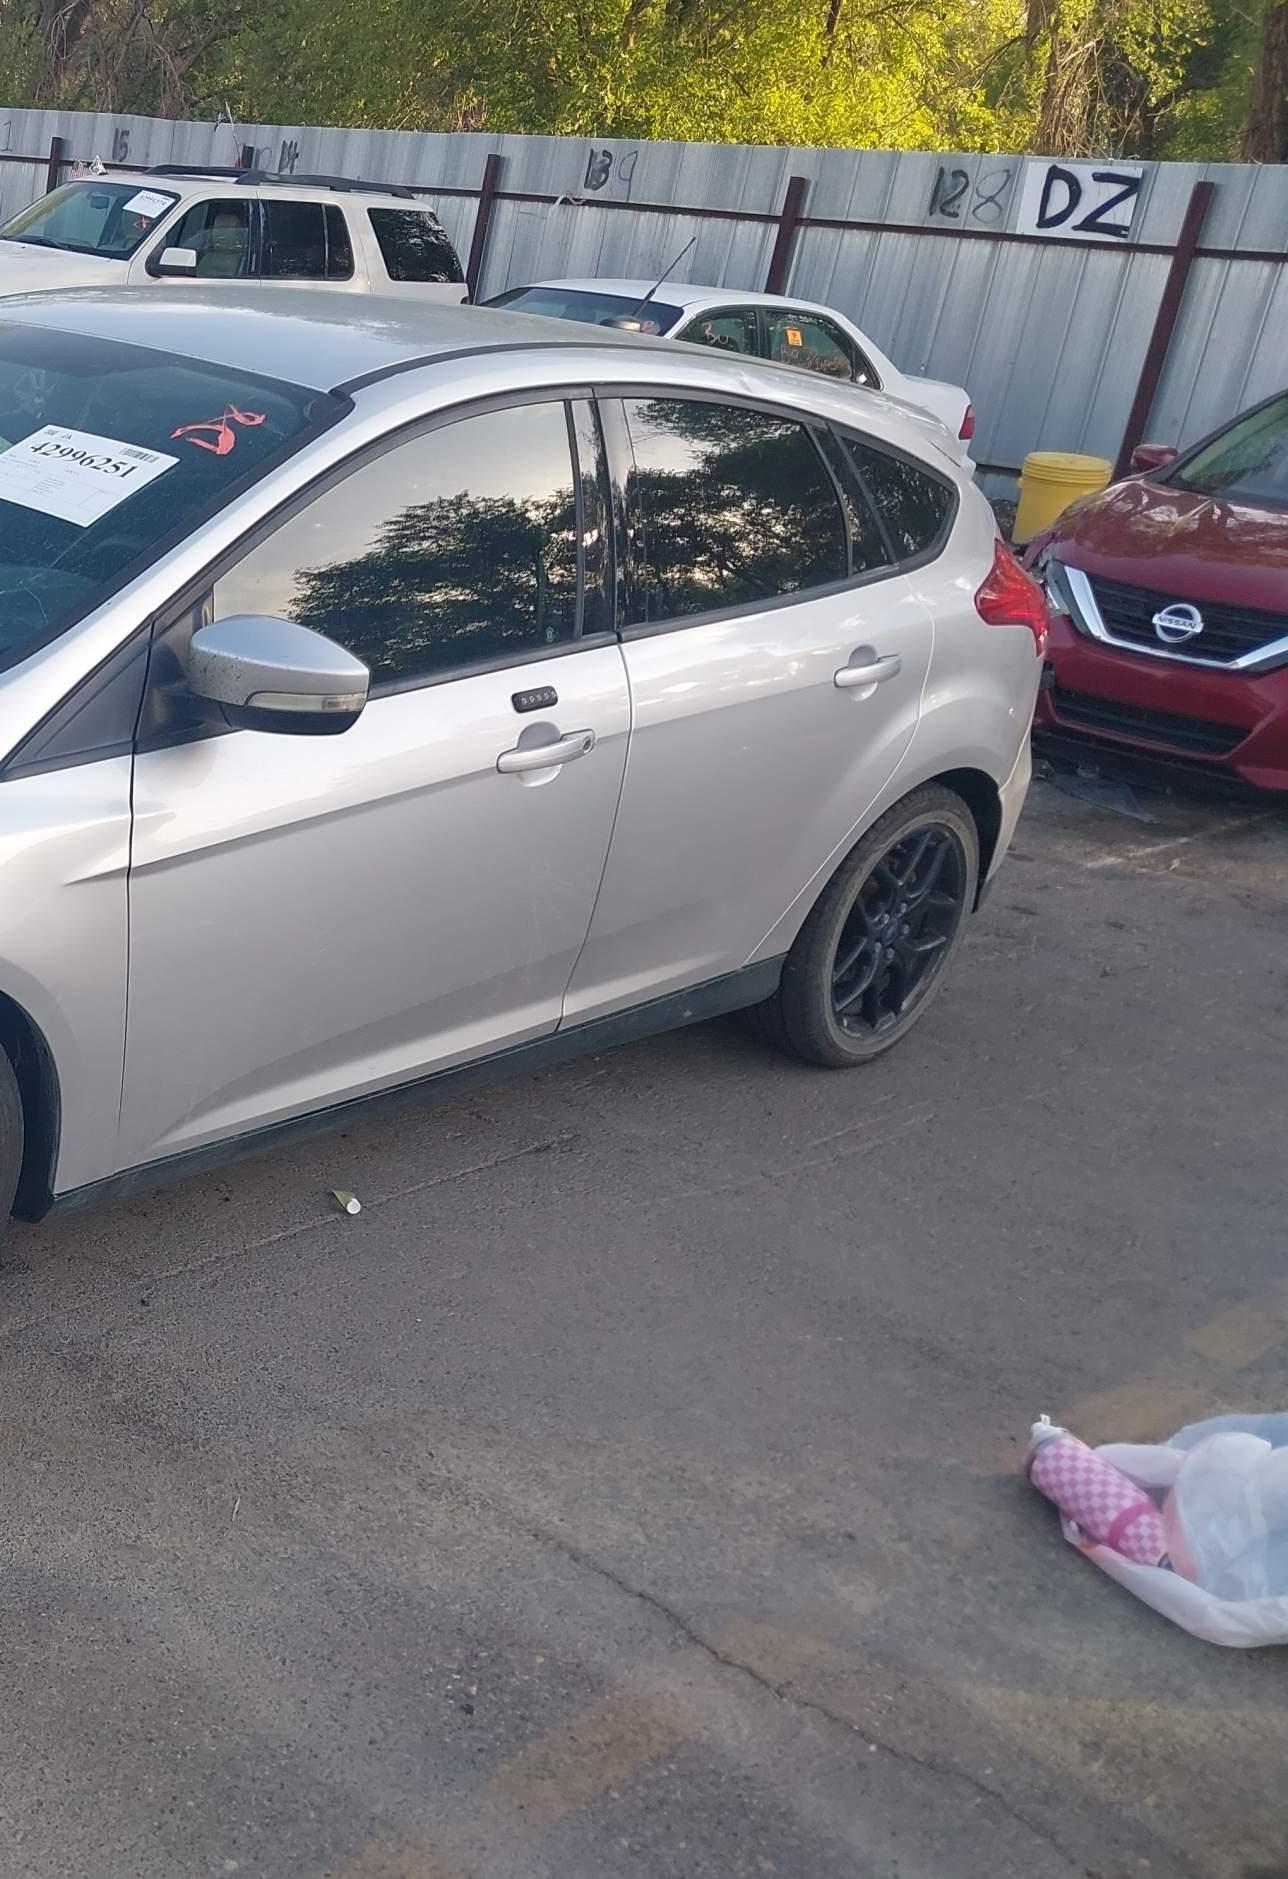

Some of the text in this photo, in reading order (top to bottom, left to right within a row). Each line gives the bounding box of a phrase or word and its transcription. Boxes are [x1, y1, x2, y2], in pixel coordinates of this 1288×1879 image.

[112, 127, 130, 162] 15
[929, 167, 969, 218] 12
[972, 169, 1011, 224] 8
[1036, 164, 1142, 238] DZ
[30, 441, 139, 478] 42996251
